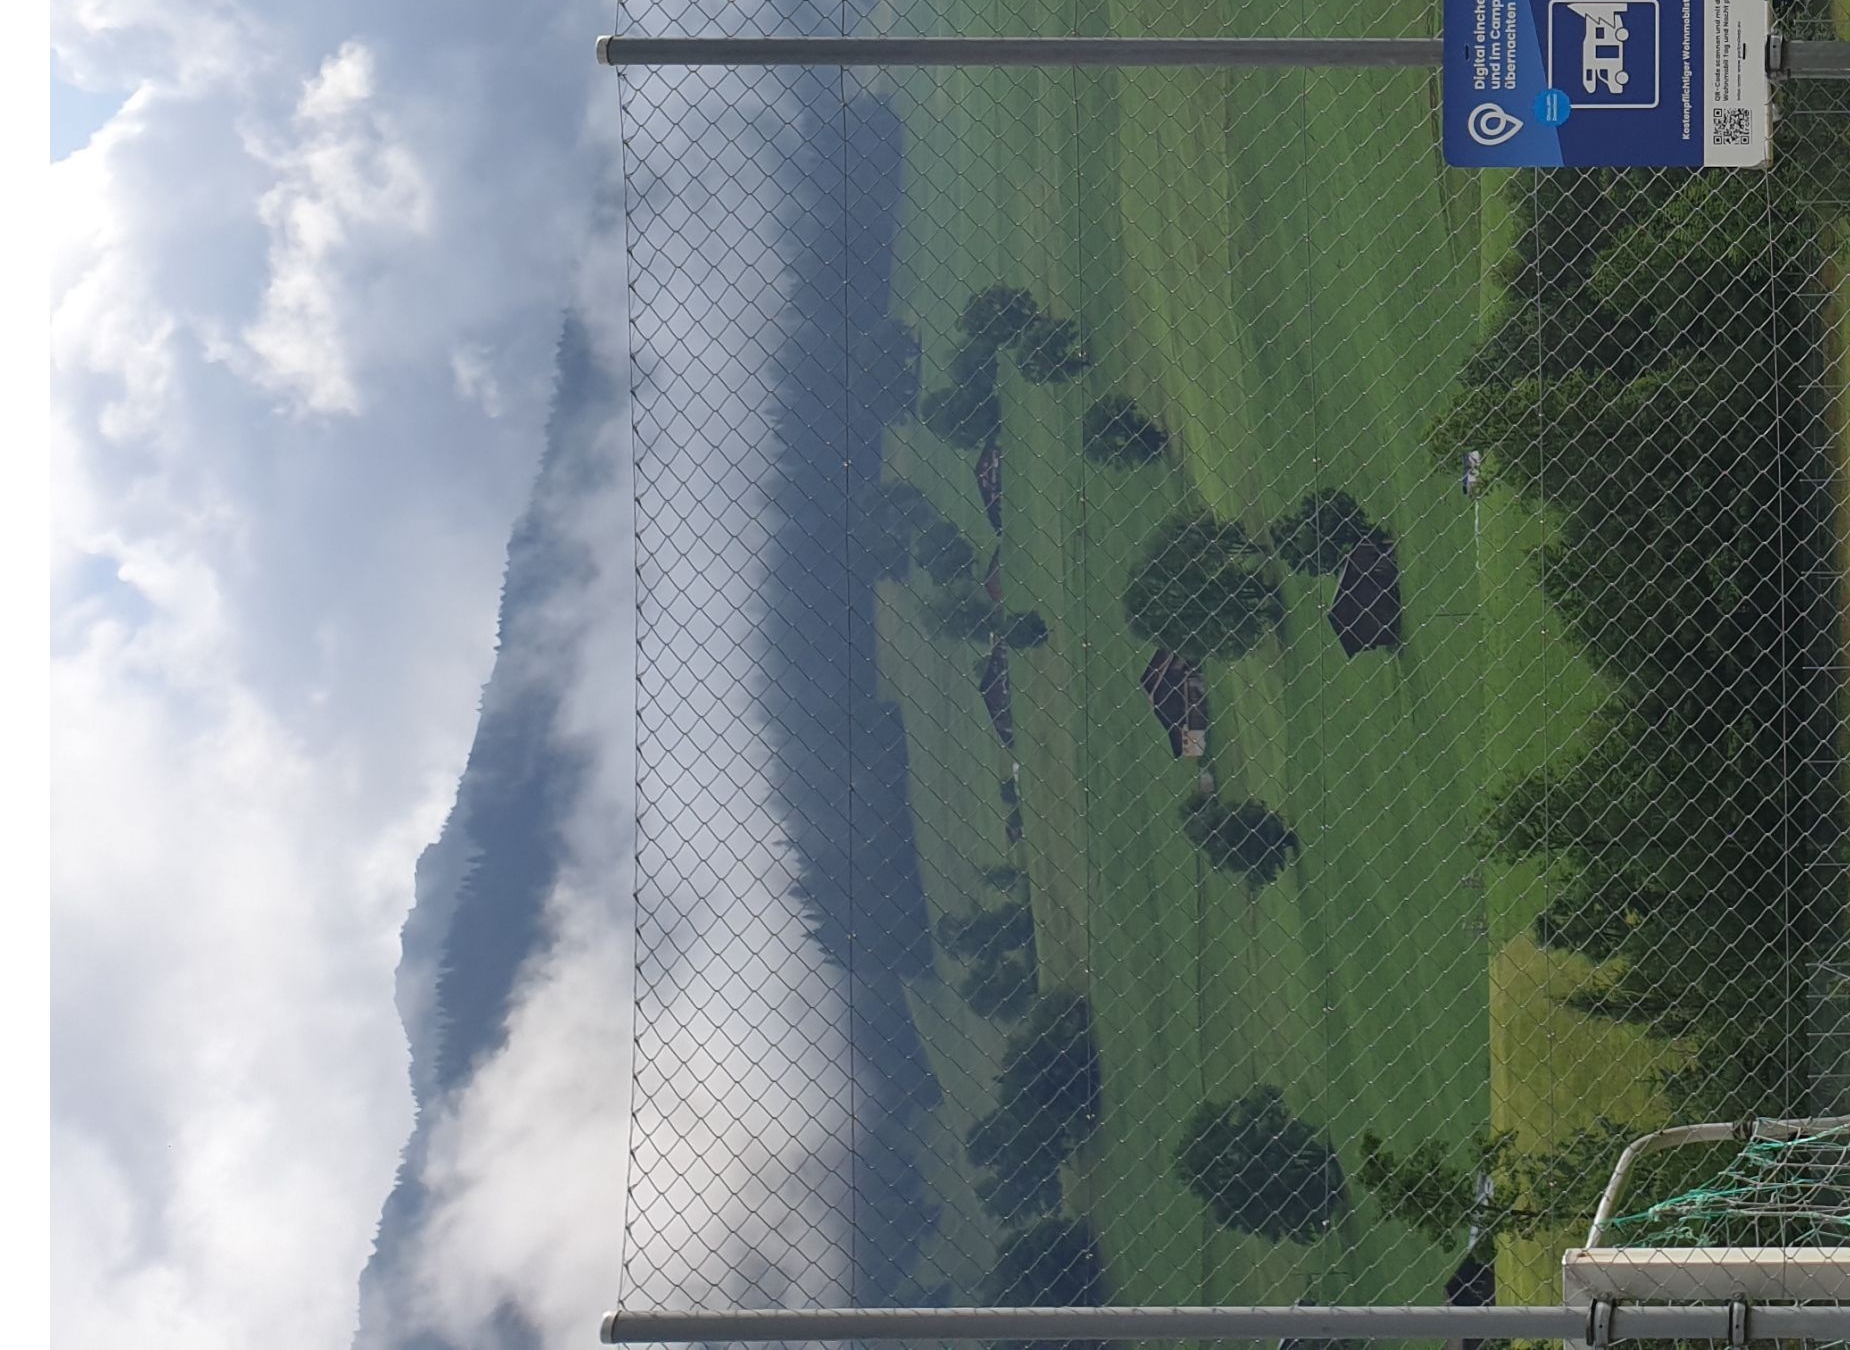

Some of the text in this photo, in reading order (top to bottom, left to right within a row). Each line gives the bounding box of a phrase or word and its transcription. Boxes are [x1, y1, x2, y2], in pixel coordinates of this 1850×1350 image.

[1489, 43, 1501, 60] im
[1505, 2, 1516, 89] übernachten
[1473, 46, 1488, 89] Digital
[1489, 63, 1501, 89] und
[1682, 61, 1692, 139] Kostenpflichtiger
